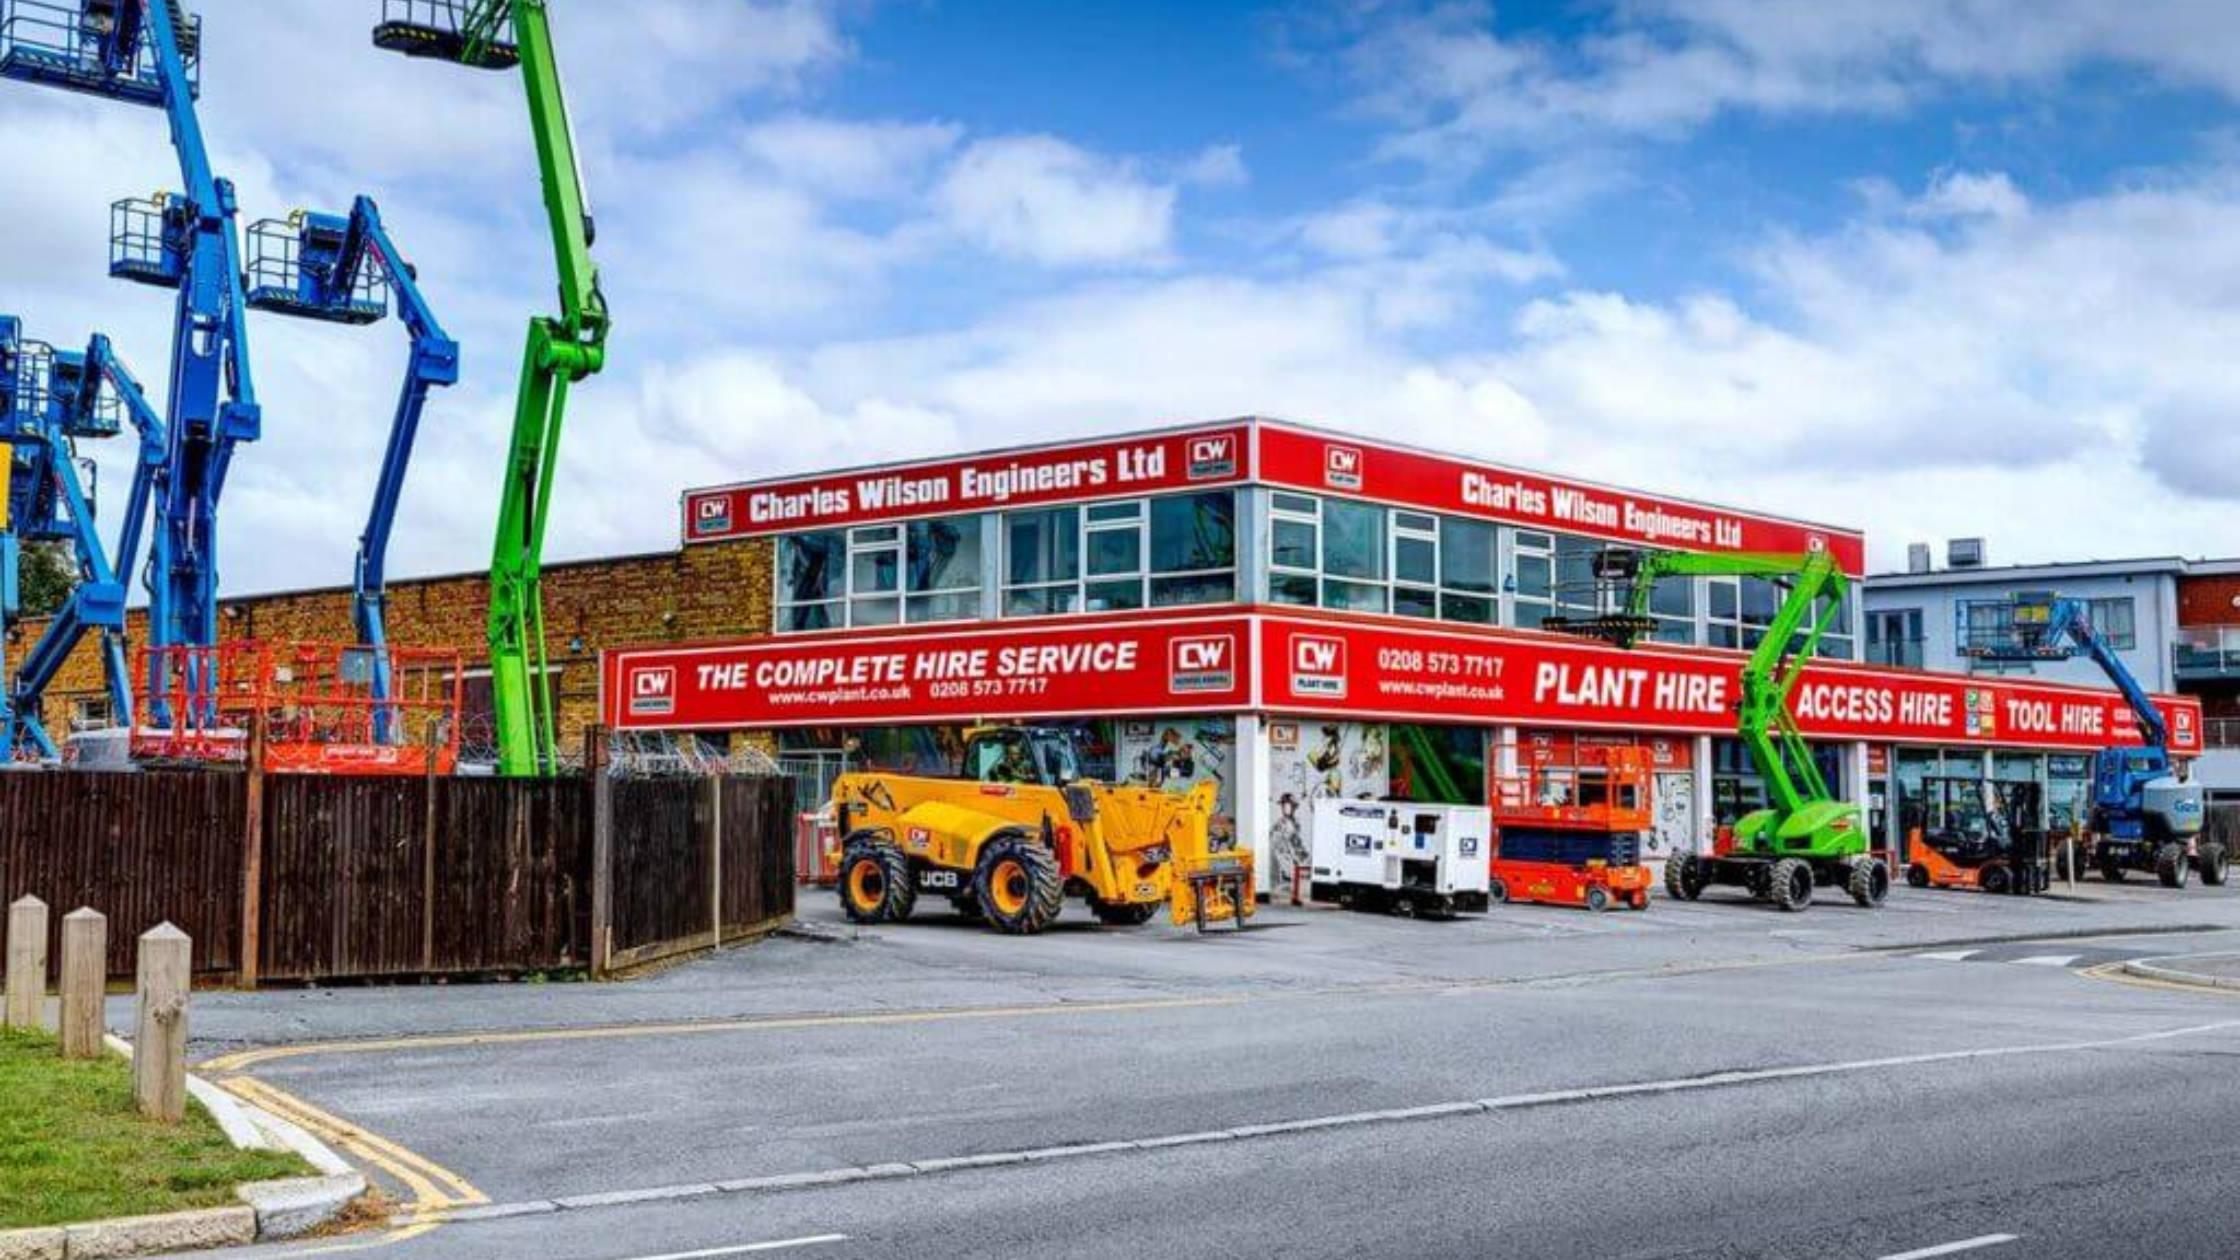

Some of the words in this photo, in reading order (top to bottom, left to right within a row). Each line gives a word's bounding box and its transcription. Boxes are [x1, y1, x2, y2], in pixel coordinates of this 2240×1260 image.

[1194, 440, 1227, 461] CW
[1330, 450, 1356, 470] CW
[750, 486, 850, 523] Charles
[857, 476, 949, 511] Wilson
[960, 458, 1107, 500] Engineers
[1117, 445, 1166, 482] Ltd
[701, 500, 727, 518] CW
[1460, 472, 1546, 515] Charles
[1553, 486, 1618, 528] Wilson
[1624, 500, 1711, 543] Engineers
[1715, 518, 1741, 548] Ltd
[697, 663, 748, 690] THE
[755, 654, 906, 688] COMPLETE
[913, 648, 989, 680] HIRE
[997, 641, 1139, 676] SERVICE
[1179, 640, 1226, 669] CW
[1298, 641, 1338, 670] CW
[1379, 647, 1422, 672] 0208
[1428, 651, 1460, 675] 573
[1463, 655, 1504, 678] 7717
[638, 672, 668, 694] CW
[768, 682, 911, 706] www.cwplant.co.uk
[929, 681, 969, 698] 0208
[973, 679, 1003, 696] 573
[1006, 677, 1049, 695] 7717
[1379, 680, 1505, 700] www.cwplant.co.uk
[1535, 661, 1648, 708] PLANT
[1654, 671, 1727, 713] HIRE
[1796, 683, 1894, 724] ACCESS
[1900, 690, 1953, 726] HIRE
[2007, 699, 2057, 732] TOOL
[2062, 703, 2103, 735] HIRE
[920, 871, 958, 887] JCB
